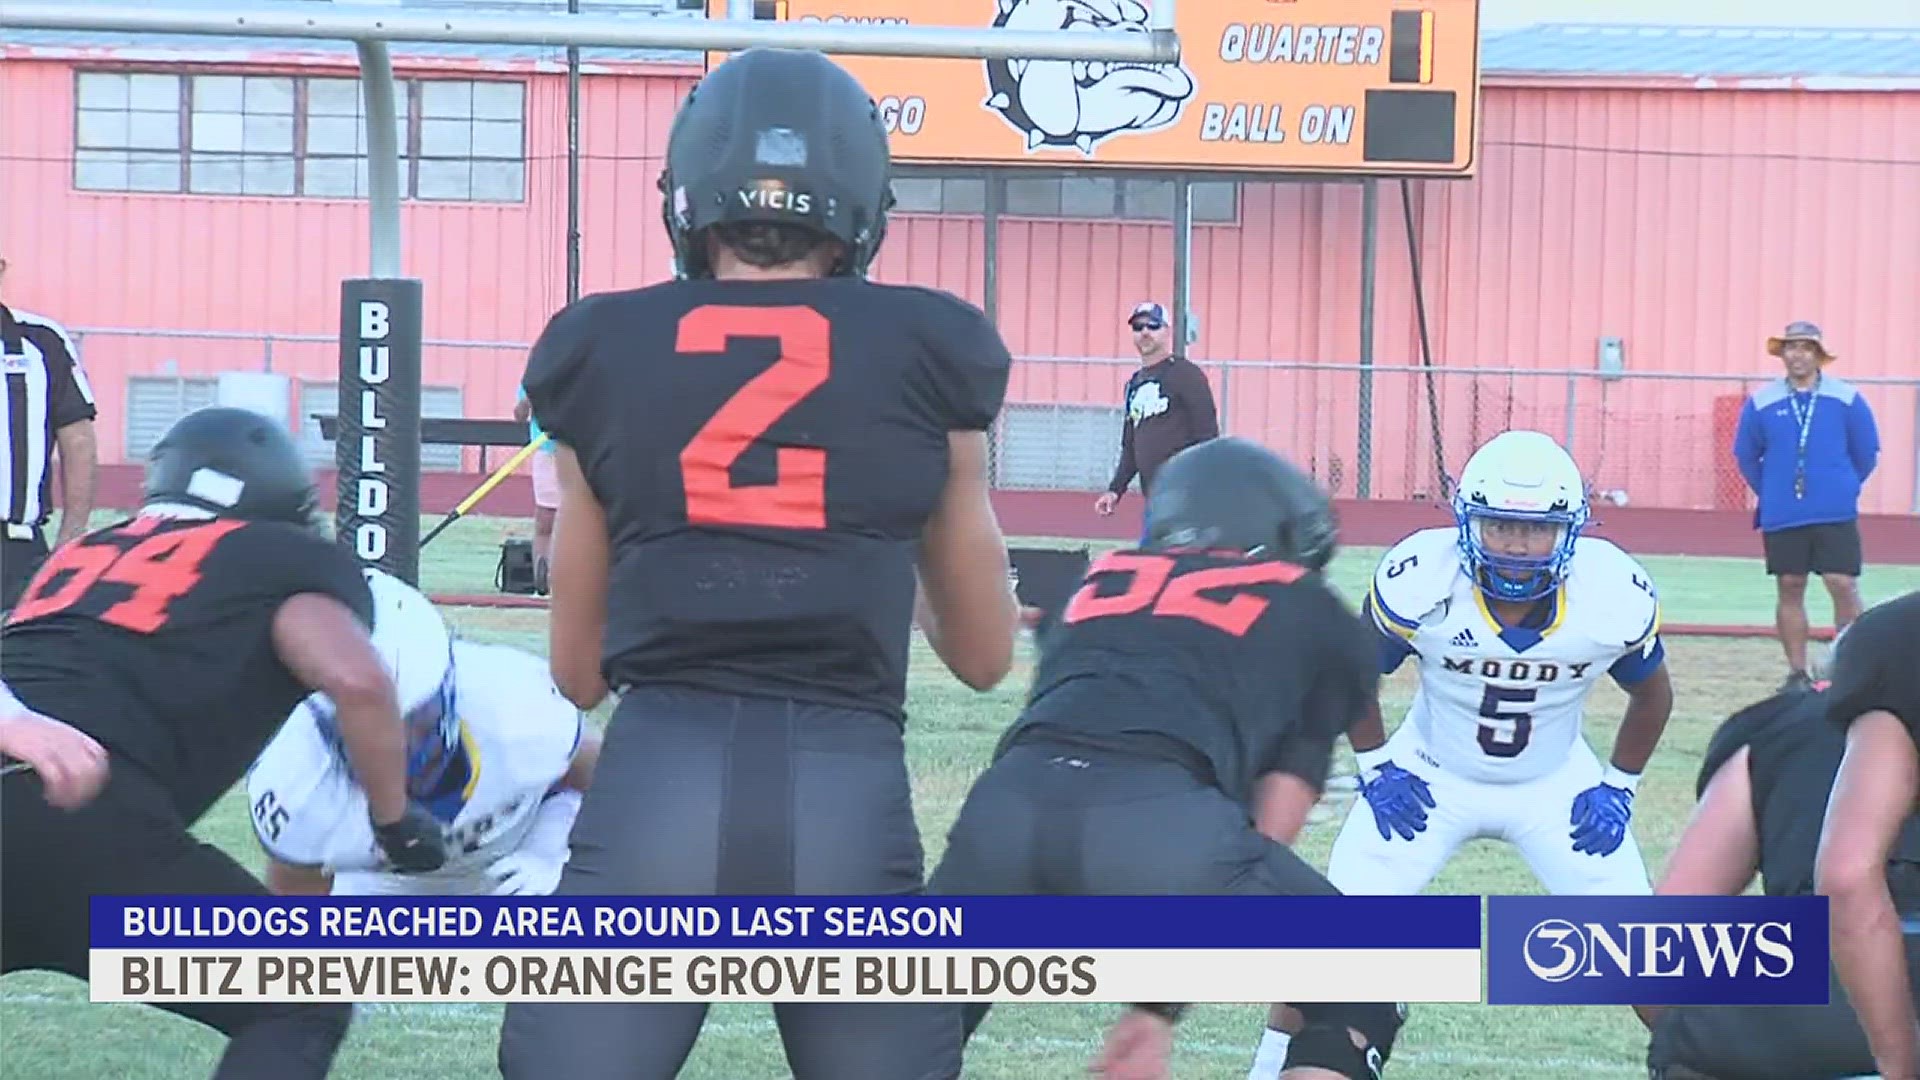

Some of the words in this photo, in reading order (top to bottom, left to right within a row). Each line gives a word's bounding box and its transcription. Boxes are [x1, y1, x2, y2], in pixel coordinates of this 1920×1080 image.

[1219, 22, 1384, 65] QUARTER
[1200, 103, 1286, 143] BALL
[1298, 104, 1356, 144] ON
[737, 189, 812, 213] VICIS
[674, 303, 831, 529] 2
[356, 300, 392, 582] BULLDO
[1386, 554, 1419, 580] 5
[1442, 656, 1594, 683] MOODY
[1475, 682, 1540, 759] 5
[252, 789, 291, 842] 65
